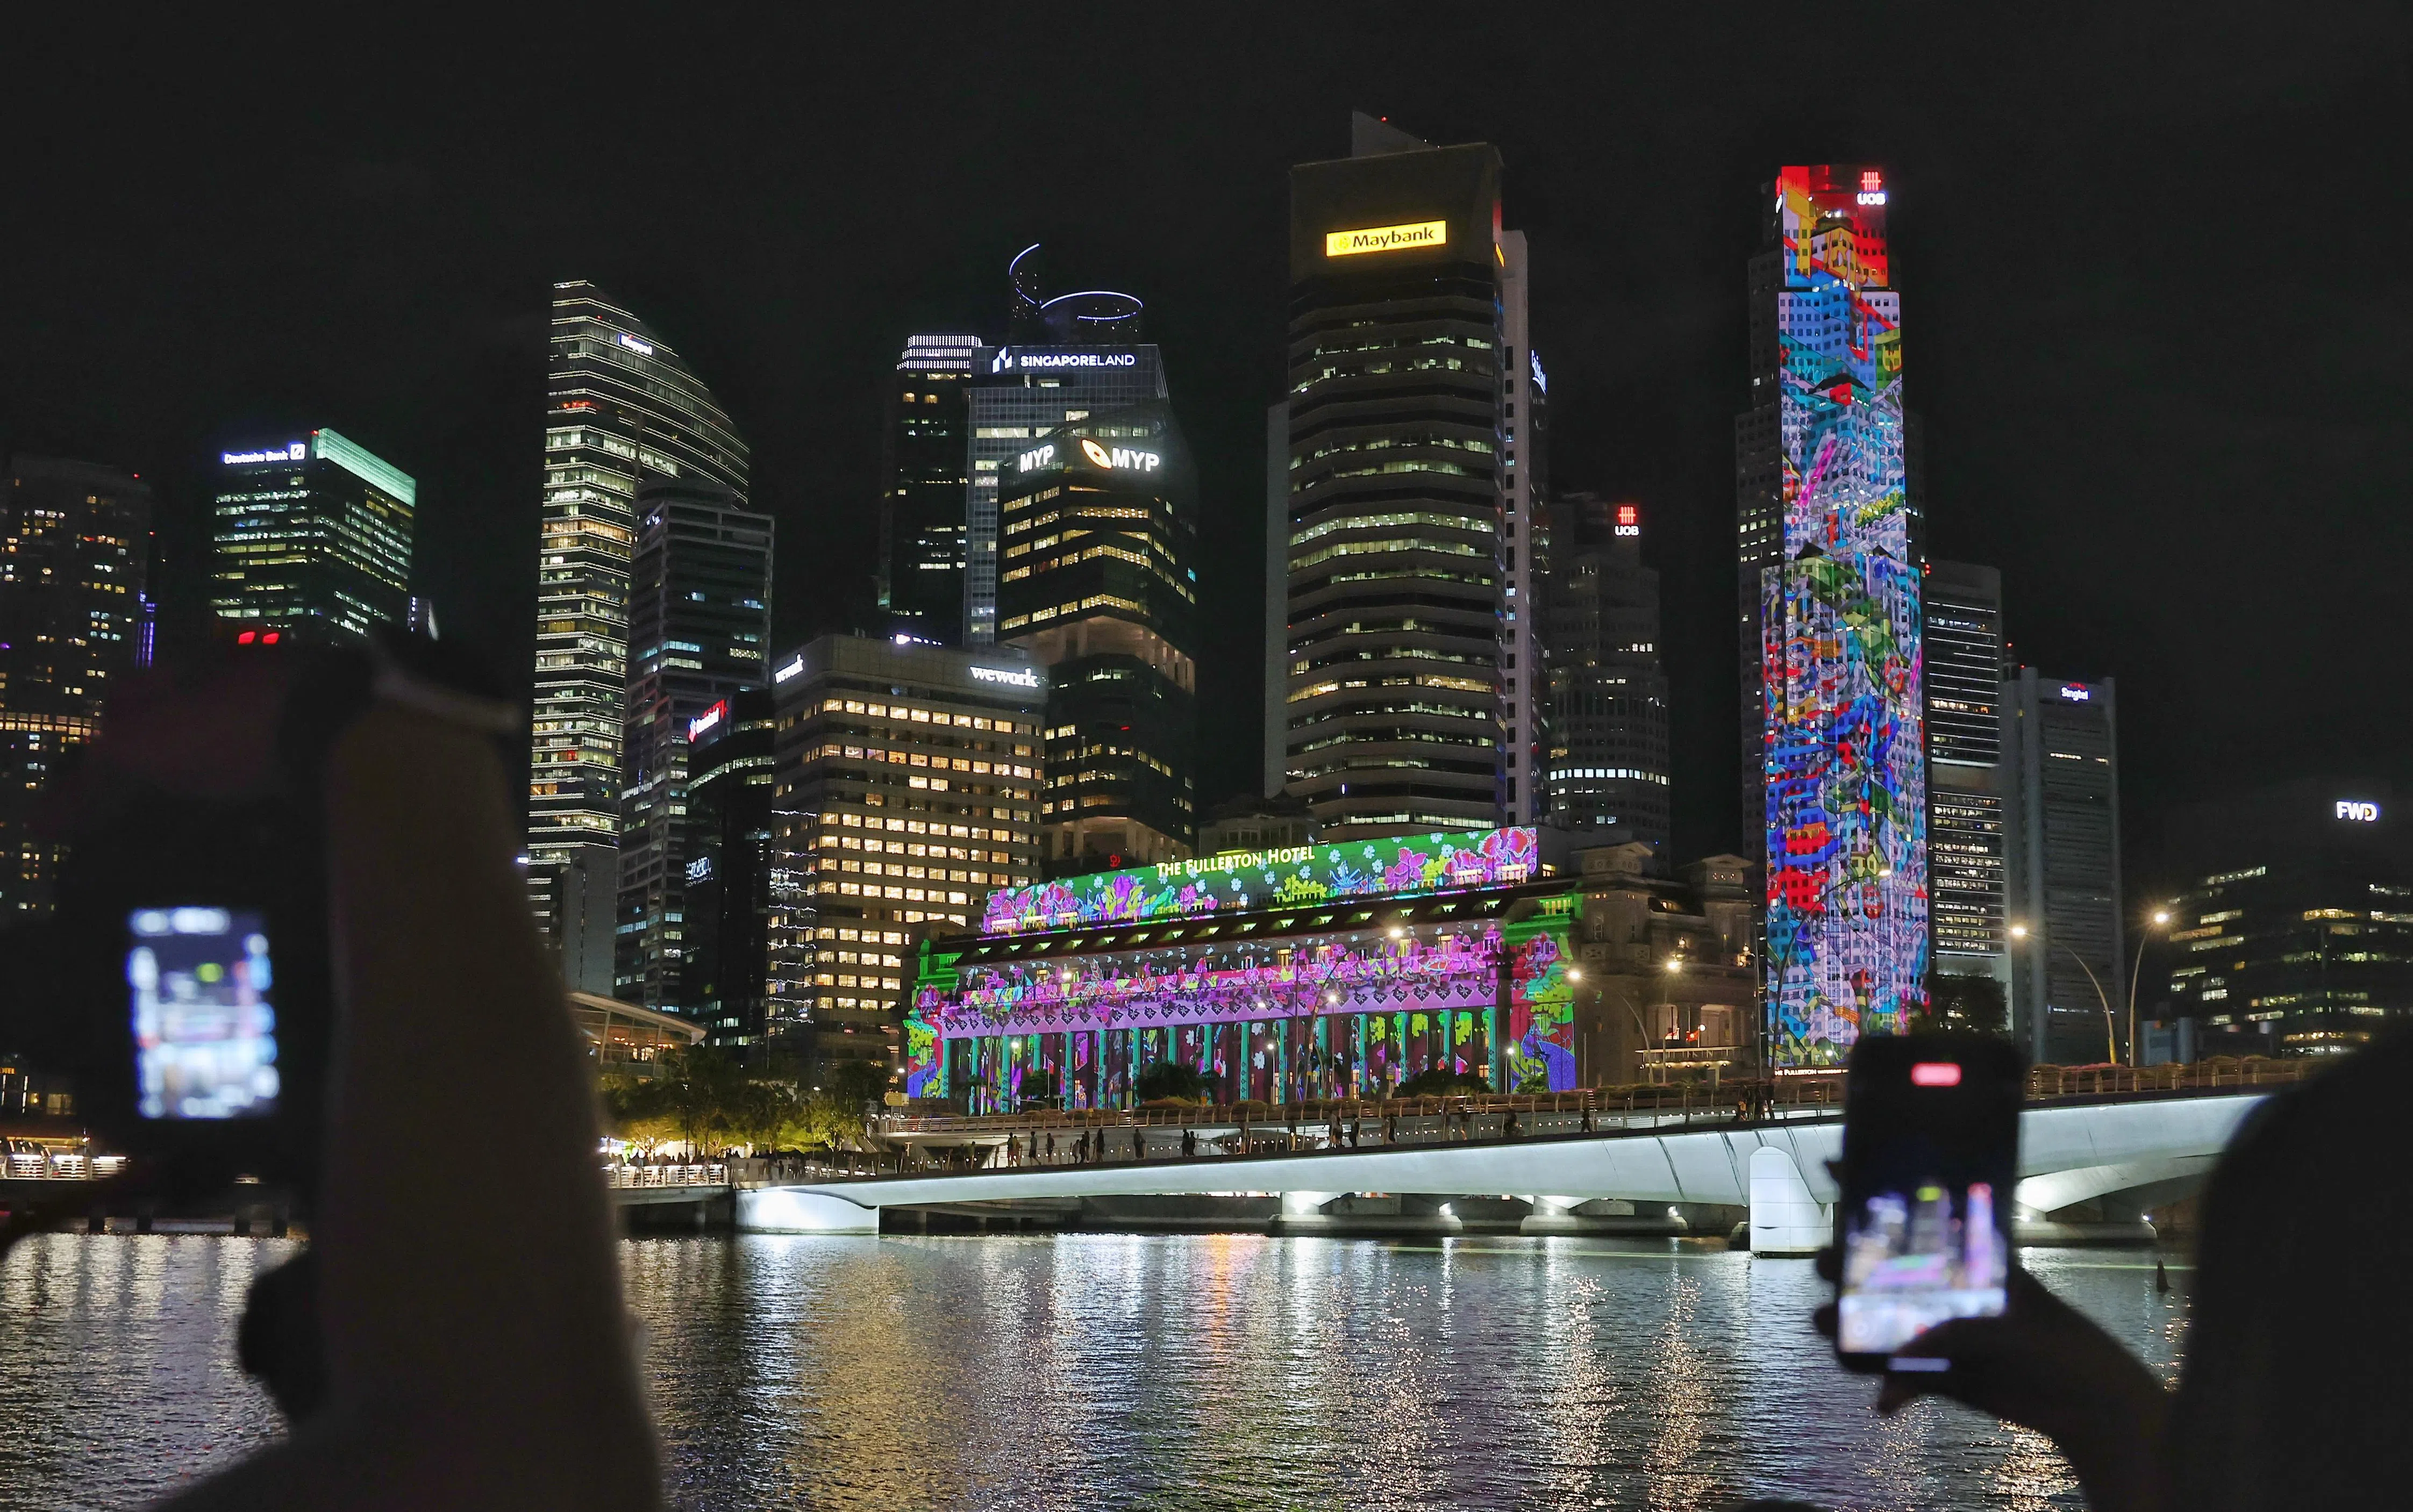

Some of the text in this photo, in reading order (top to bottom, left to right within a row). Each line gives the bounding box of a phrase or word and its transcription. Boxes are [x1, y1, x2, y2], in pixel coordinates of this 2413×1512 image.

[1857, 192, 1886, 205] UOB
[1353, 226, 1434, 248] Maybank
[1020, 354, 1136, 368] SINGAPORELAND
[224, 450, 289, 464] Deutsche Bank
[1020, 444, 1054, 473] MYP
[1111, 447, 1160, 472] MYP
[1615, 525, 1640, 536] UOB
[775, 654, 804, 684] wework
[969, 668, 1039, 689] wework
[2061, 687, 2089, 701] Singtel
[2336, 801, 2378, 822] FWD
[1156, 845, 1316, 877] THE FULLERTON HOTEL
